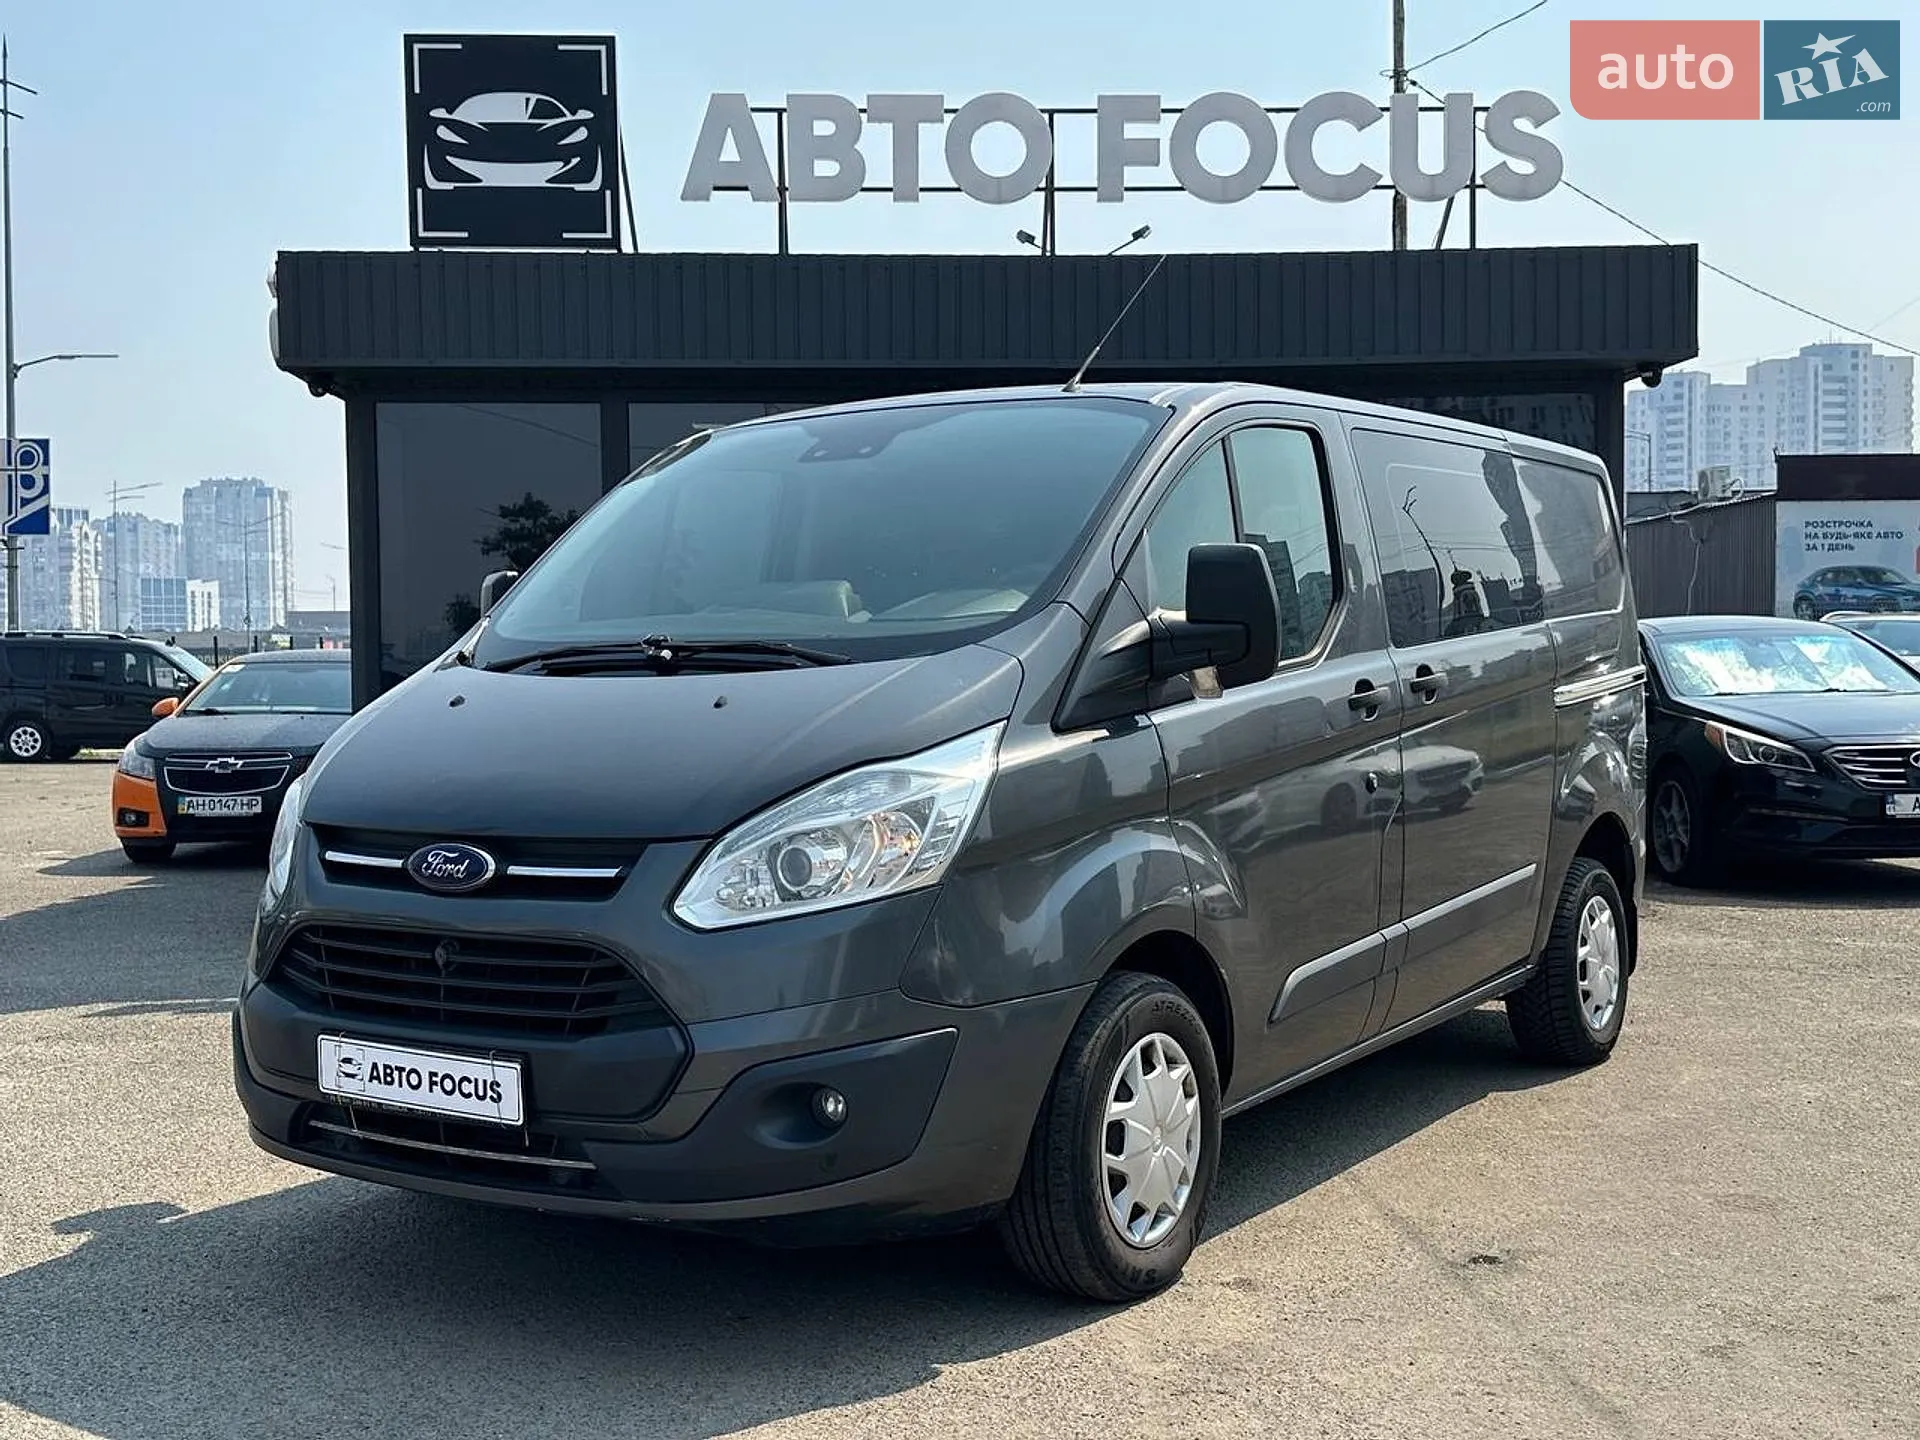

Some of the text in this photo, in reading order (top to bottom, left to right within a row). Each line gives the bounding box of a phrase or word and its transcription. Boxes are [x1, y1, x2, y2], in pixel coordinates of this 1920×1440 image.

[680, 90, 1564, 205] АВТО FOCUS
[1804, 520, 1873, 529] РОЗСТРОЧКА
[1804, 532, 1819, 540] НА
[1875, 531, 1904, 540] АВТО
[1805, 543, 1818, 551] ЗА
[1827, 543, 1855, 552] ДЕНЬ
[208, 799, 238, 811] 0147
[421, 850, 470, 879] Ford
[368, 1061, 503, 1104] АВТО FOCUS
